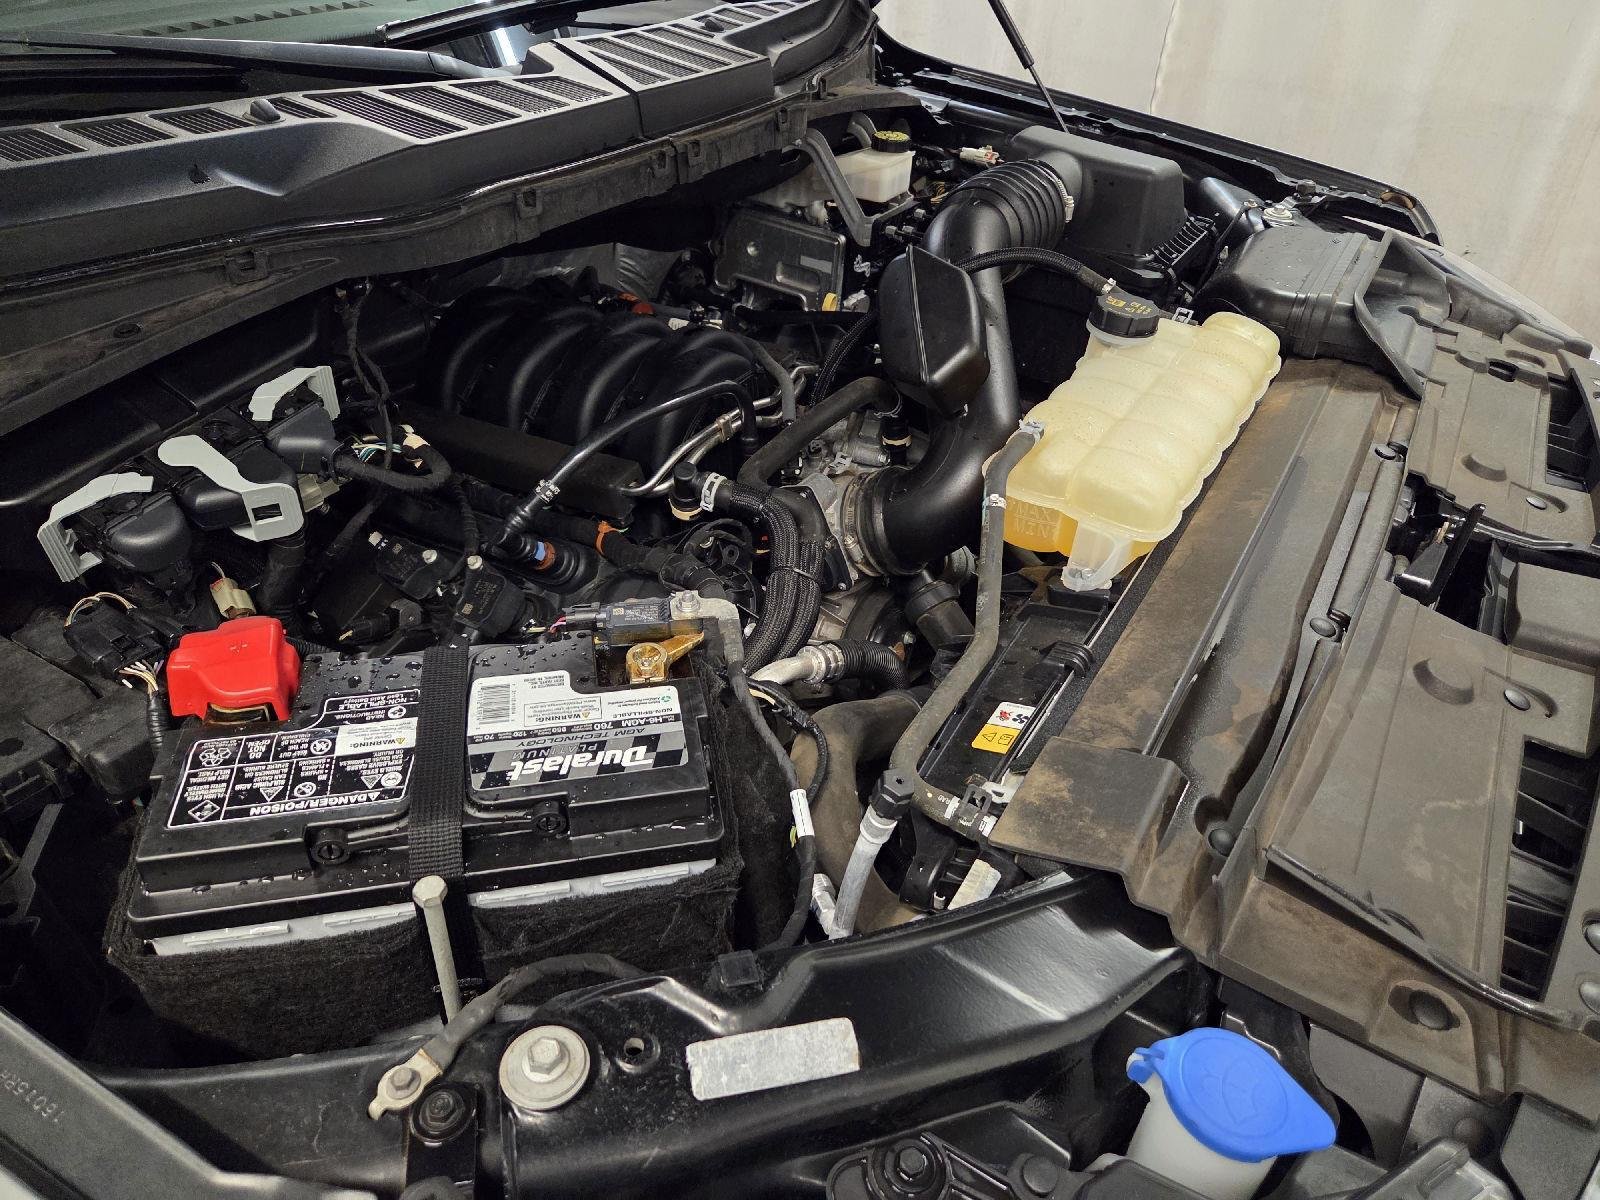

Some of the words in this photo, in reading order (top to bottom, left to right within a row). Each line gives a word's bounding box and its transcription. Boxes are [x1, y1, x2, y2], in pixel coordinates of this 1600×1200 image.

[338, 698, 407, 710] NON-SPILLABLE
[535, 714, 580, 722] WARNING:
[612, 708, 672, 718] NON-SPILLABLE
[593, 722, 614, 730] 760
[614, 728, 645, 736] AGM
[350, 739, 396, 748] WARNING:
[516, 732, 609, 747] TECHNOLOGY
[512, 743, 598, 760] PLATINUM
[506, 745, 653, 780] Duralast
[250, 794, 368, 816] DANGER/POISON
